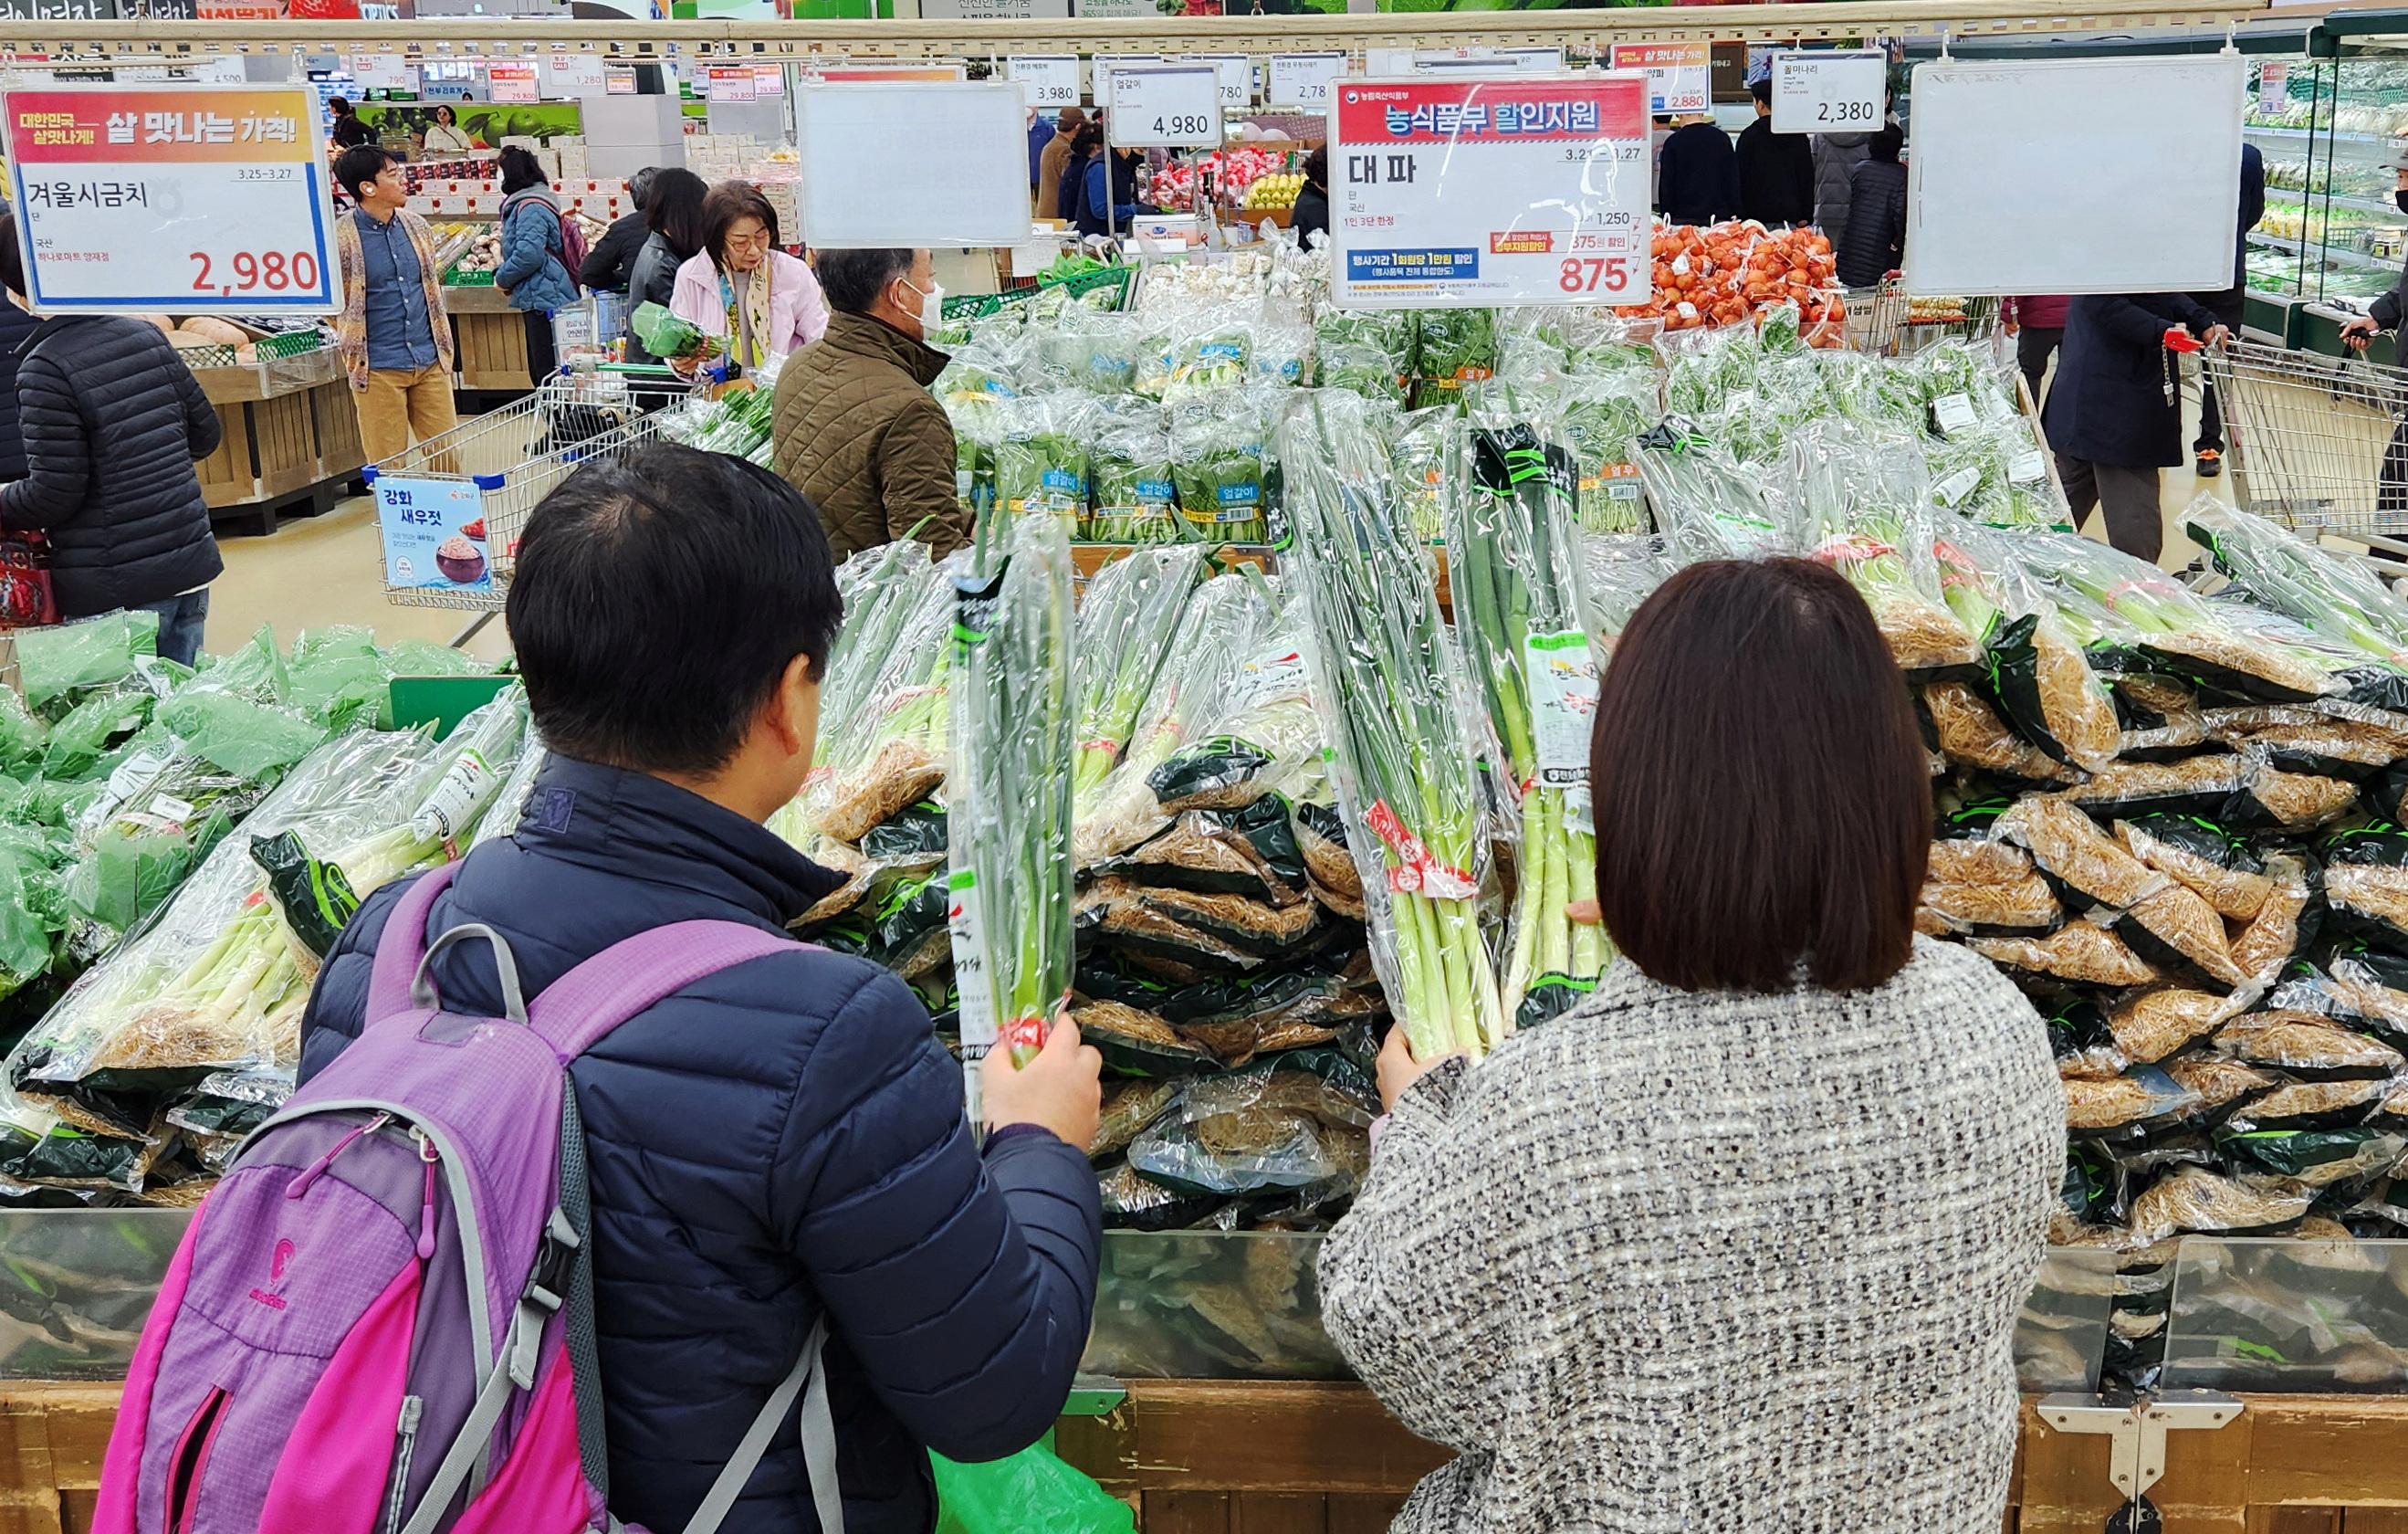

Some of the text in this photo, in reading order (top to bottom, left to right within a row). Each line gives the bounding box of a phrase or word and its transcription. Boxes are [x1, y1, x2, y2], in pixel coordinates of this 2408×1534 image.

[362, 4, 398, 19] OPTICS
[389, 76, 404, 84] 790
[576, 77, 601, 85] 1,280
[1116, 79, 1142, 89] 얼갈이
[1038, 87, 1073, 100] 3,980
[1220, 87, 1241, 99] 780
[1299, 86, 1326, 100] 2,78
[1361, 91, 1409, 101] 농림축산식품부
[1671, 95, 1704, 108] 2,880
[1385, 100, 1598, 134] 농식품부 할인지원
[1817, 101, 1874, 123] 2,380
[20, 112, 75, 129] 대한민국
[106, 110, 297, 144] 살 맛나는 가격!
[1153, 116, 1208, 137] 4,980
[33, 130, 95, 145] 살맛나게!
[28, 182, 148, 208] 겨울시금치
[1348, 190, 1357, 201] 단
[1348, 203, 1366, 213] 국산
[32, 212, 41, 222] 단
[1344, 215, 1395, 227] 1인 3단 한정
[1597, 212, 1630, 226] 1,250
[36, 238, 53, 248] 국산
[1607, 237, 1626, 247] 할인
[37, 252, 110, 263] 하나로마트 양재점
[1353, 252, 1472, 266] 행사기간 1회원당 1만원 할인
[189, 251, 318, 297] 2,980
[1559, 257, 1628, 292] 875
[1049, 473, 1076, 489] 얼갈이
[1143, 483, 1173, 497] 얼갈이
[1223, 487, 1253, 500] 얼갈이
[383, 489, 413, 506] 강화
[401, 509, 443, 527] 새우젓
